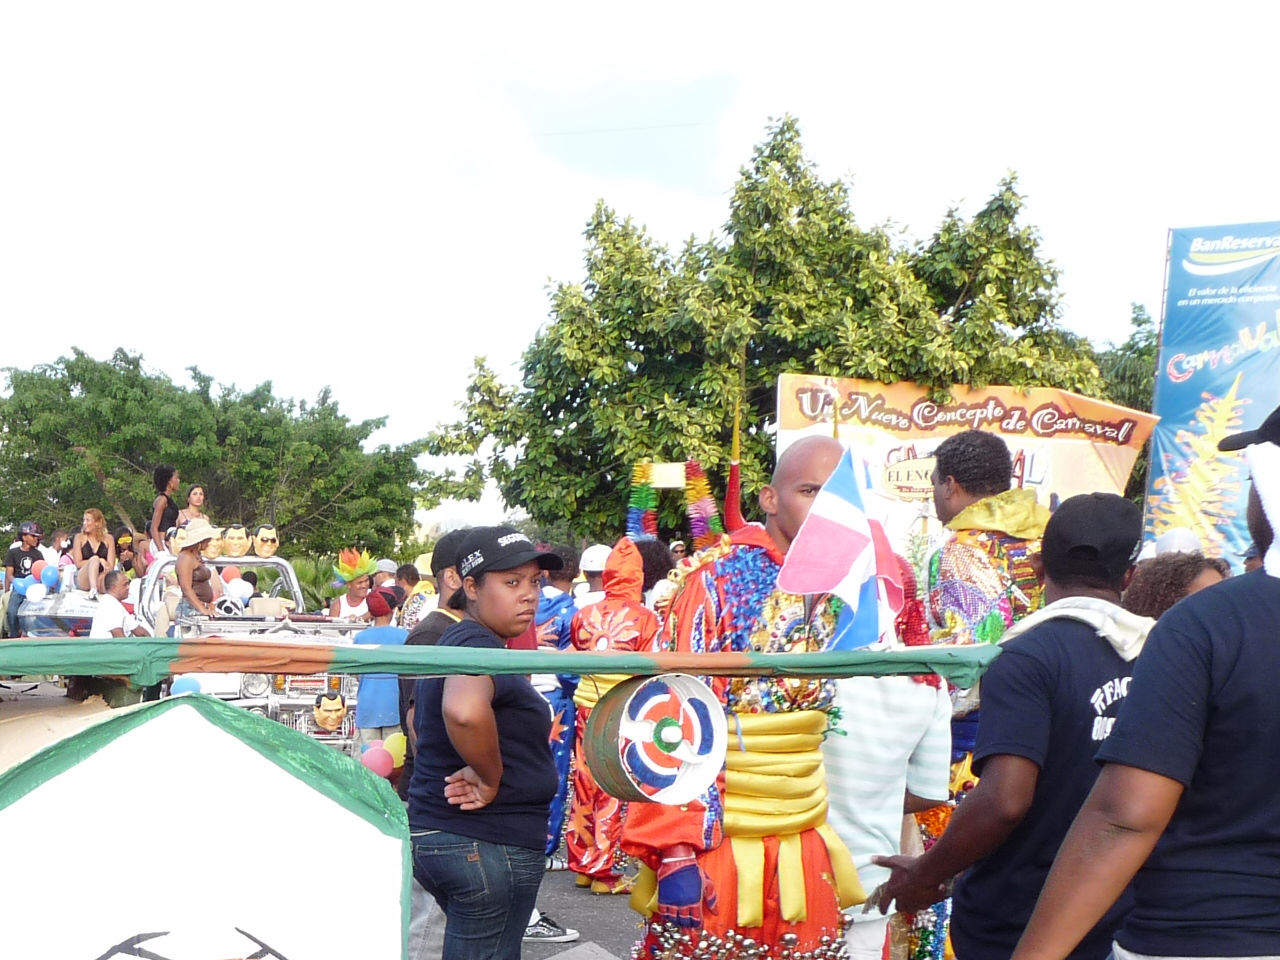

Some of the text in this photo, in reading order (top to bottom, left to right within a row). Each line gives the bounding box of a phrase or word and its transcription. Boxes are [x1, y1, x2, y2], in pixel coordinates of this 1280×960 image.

[1190, 236, 1280, 251] BanReserva
[841, 394, 910, 429] Nuevo
[912, 399, 1005, 428] Concepto
[1001, 409, 1027, 431] de
